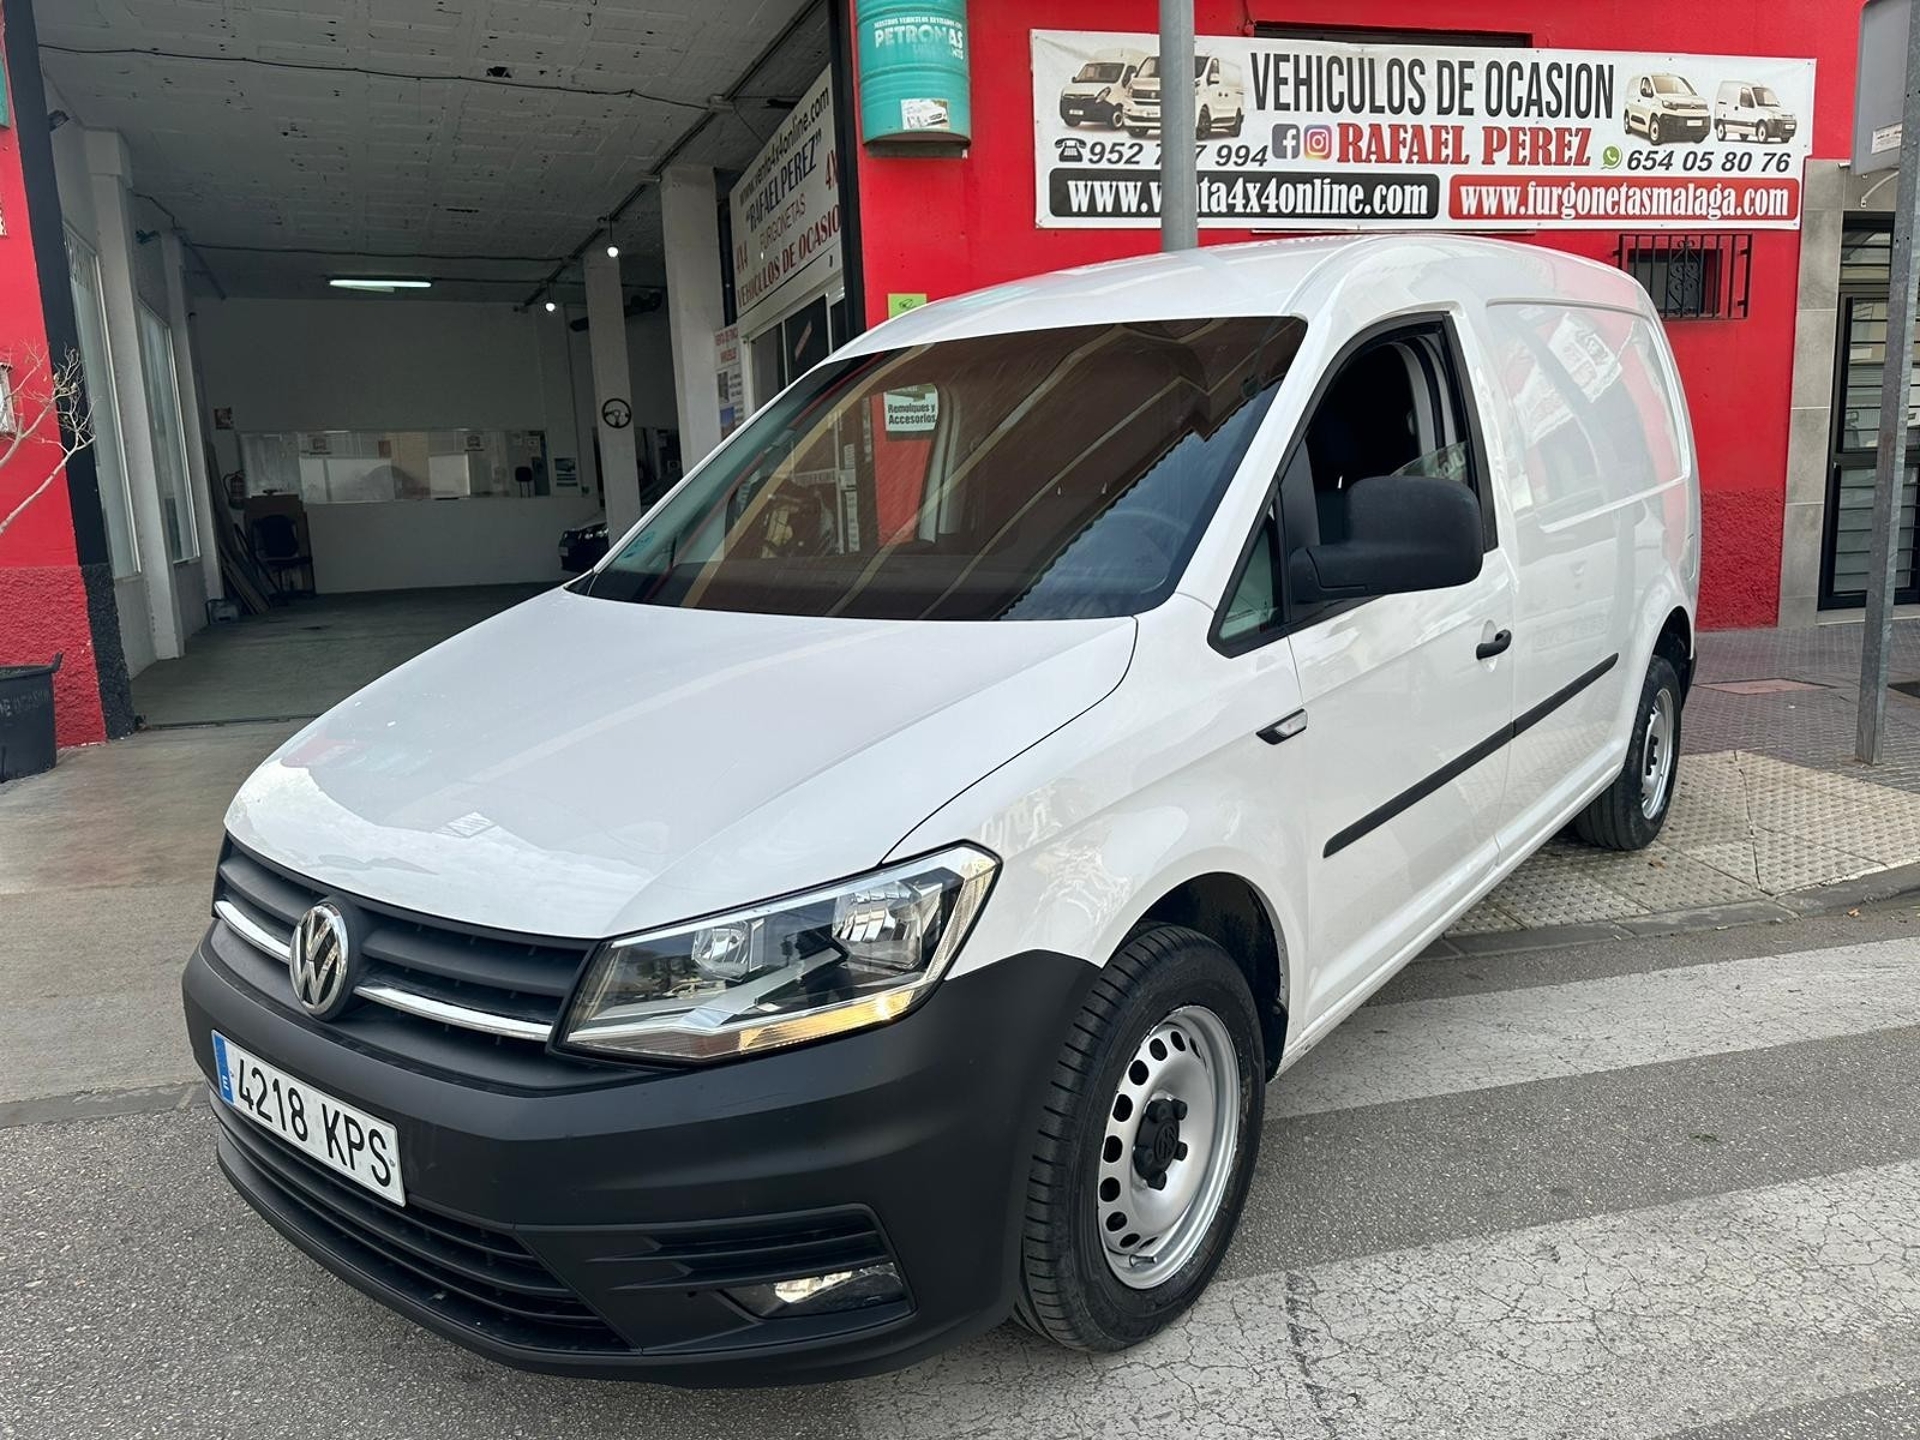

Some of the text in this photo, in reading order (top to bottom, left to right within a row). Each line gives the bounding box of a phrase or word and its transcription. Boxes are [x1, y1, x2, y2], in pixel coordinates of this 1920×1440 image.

[875, 24, 963, 48] PETRONAS
[1250, 52, 1614, 118] VEHICULOS DE OCASION
[1087, 141, 1144, 166] 952
[1215, 144, 1268, 168] 994
[1337, 121, 1470, 165] RAFAEL
[1482, 124, 1592, 166] PEREZ
[1626, 149, 1792, 173] 654 05 80 76
[1067, 176, 1429, 215] www.vta4x4online.com
[1459, 180, 1789, 220] www.furgonetasmalaga.com
[782, 241, 797, 274] DE
[888, 403, 929, 413] Remolques
[889, 414, 936, 424] Accesorios
[238, 1058, 392, 1188] 4218 KPS
